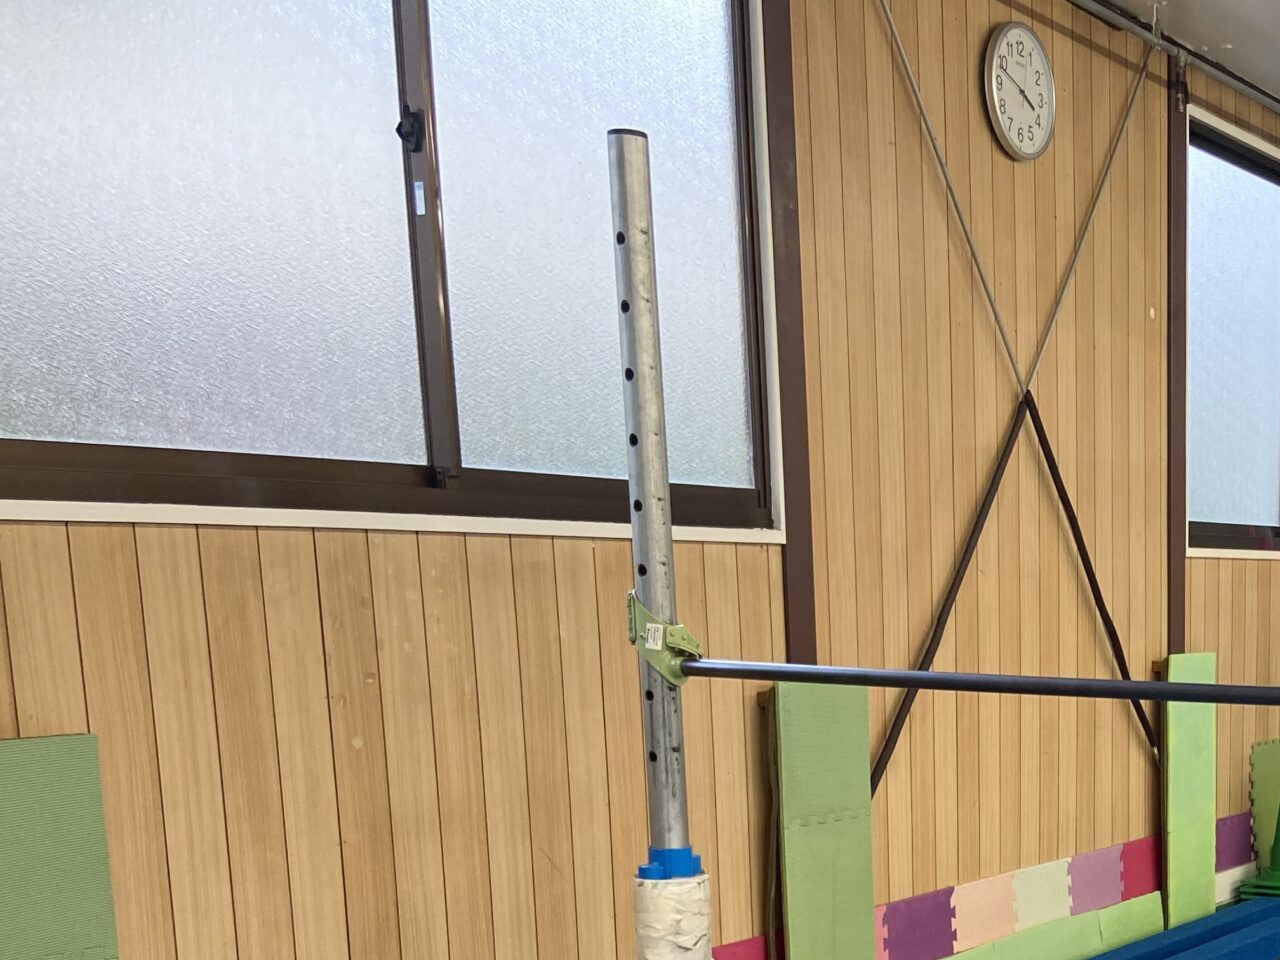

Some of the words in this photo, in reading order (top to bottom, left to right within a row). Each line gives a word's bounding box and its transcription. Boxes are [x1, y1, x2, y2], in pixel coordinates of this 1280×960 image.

[1007, 42, 1013, 58] 11
[1016, 41, 1024, 58] 12
[999, 54, 1008, 72] 10
[1029, 52, 1033, 67] 1
[996, 74, 1003, 91] 9
[1035, 70, 1041, 86] 2
[1000, 98, 1006, 114] 8
[1038, 93, 1044, 109] 3
[1007, 116, 1014, 132] 7
[1035, 114, 1041, 129] 4
[1017, 127, 1024, 143] 6
[1028, 125, 1034, 141] 5
